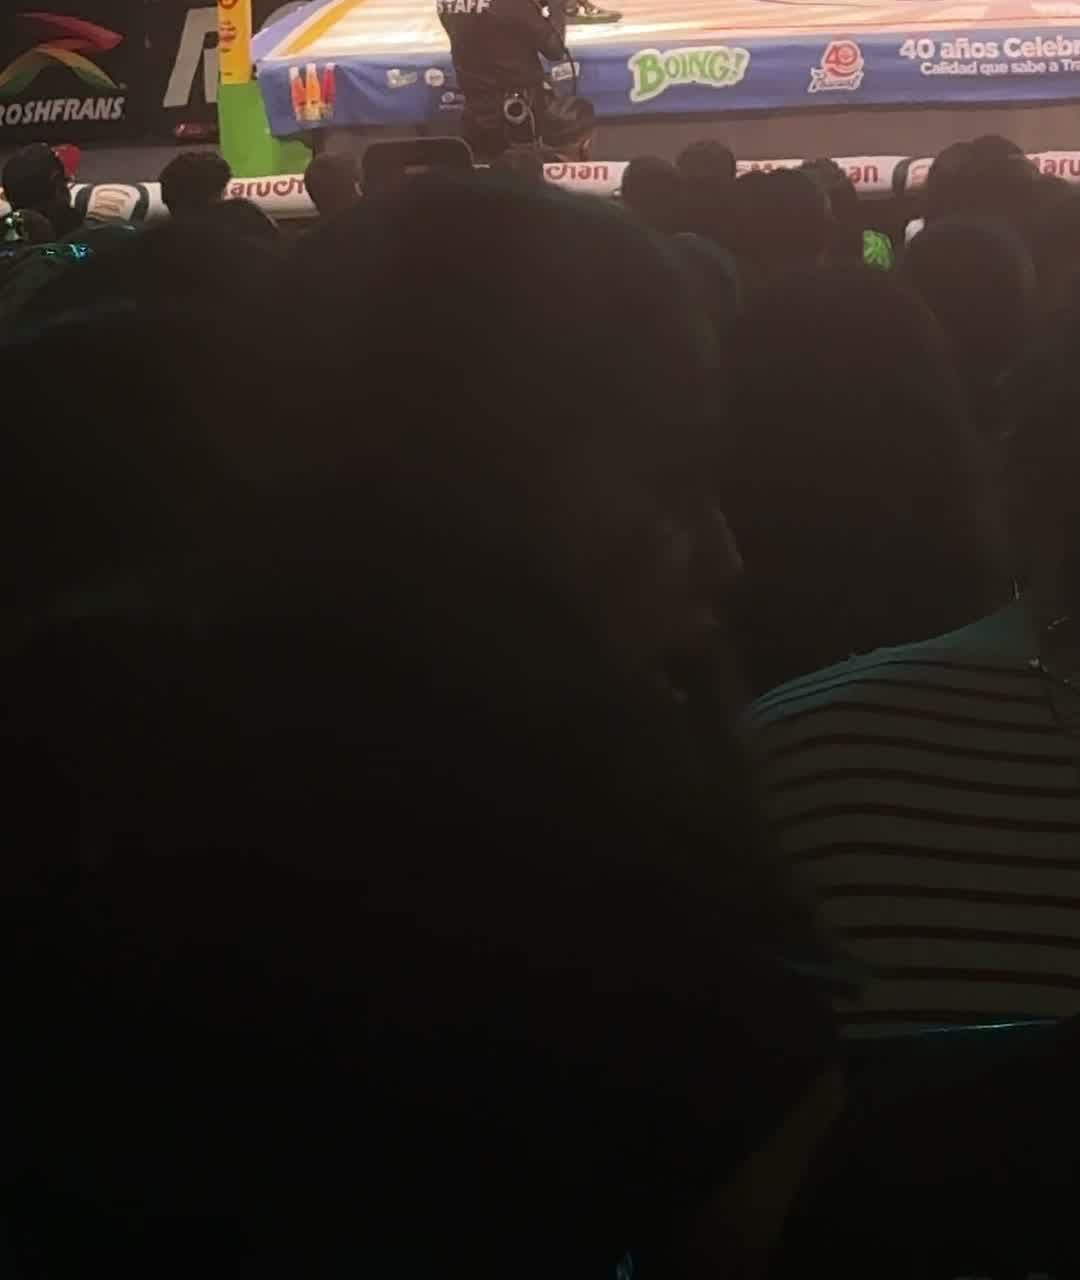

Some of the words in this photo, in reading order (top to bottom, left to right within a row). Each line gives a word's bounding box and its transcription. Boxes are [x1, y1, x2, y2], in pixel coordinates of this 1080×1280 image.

[900, 38, 935, 59] 40
[940, 37, 999, 59] años
[921, 60, 977, 75] Calidad
[980, 62, 1008, 77] que
[1011, 60, 1046, 74] sabe
[1049, 62, 1059, 73] a
[224, 177, 304, 197] aruch
